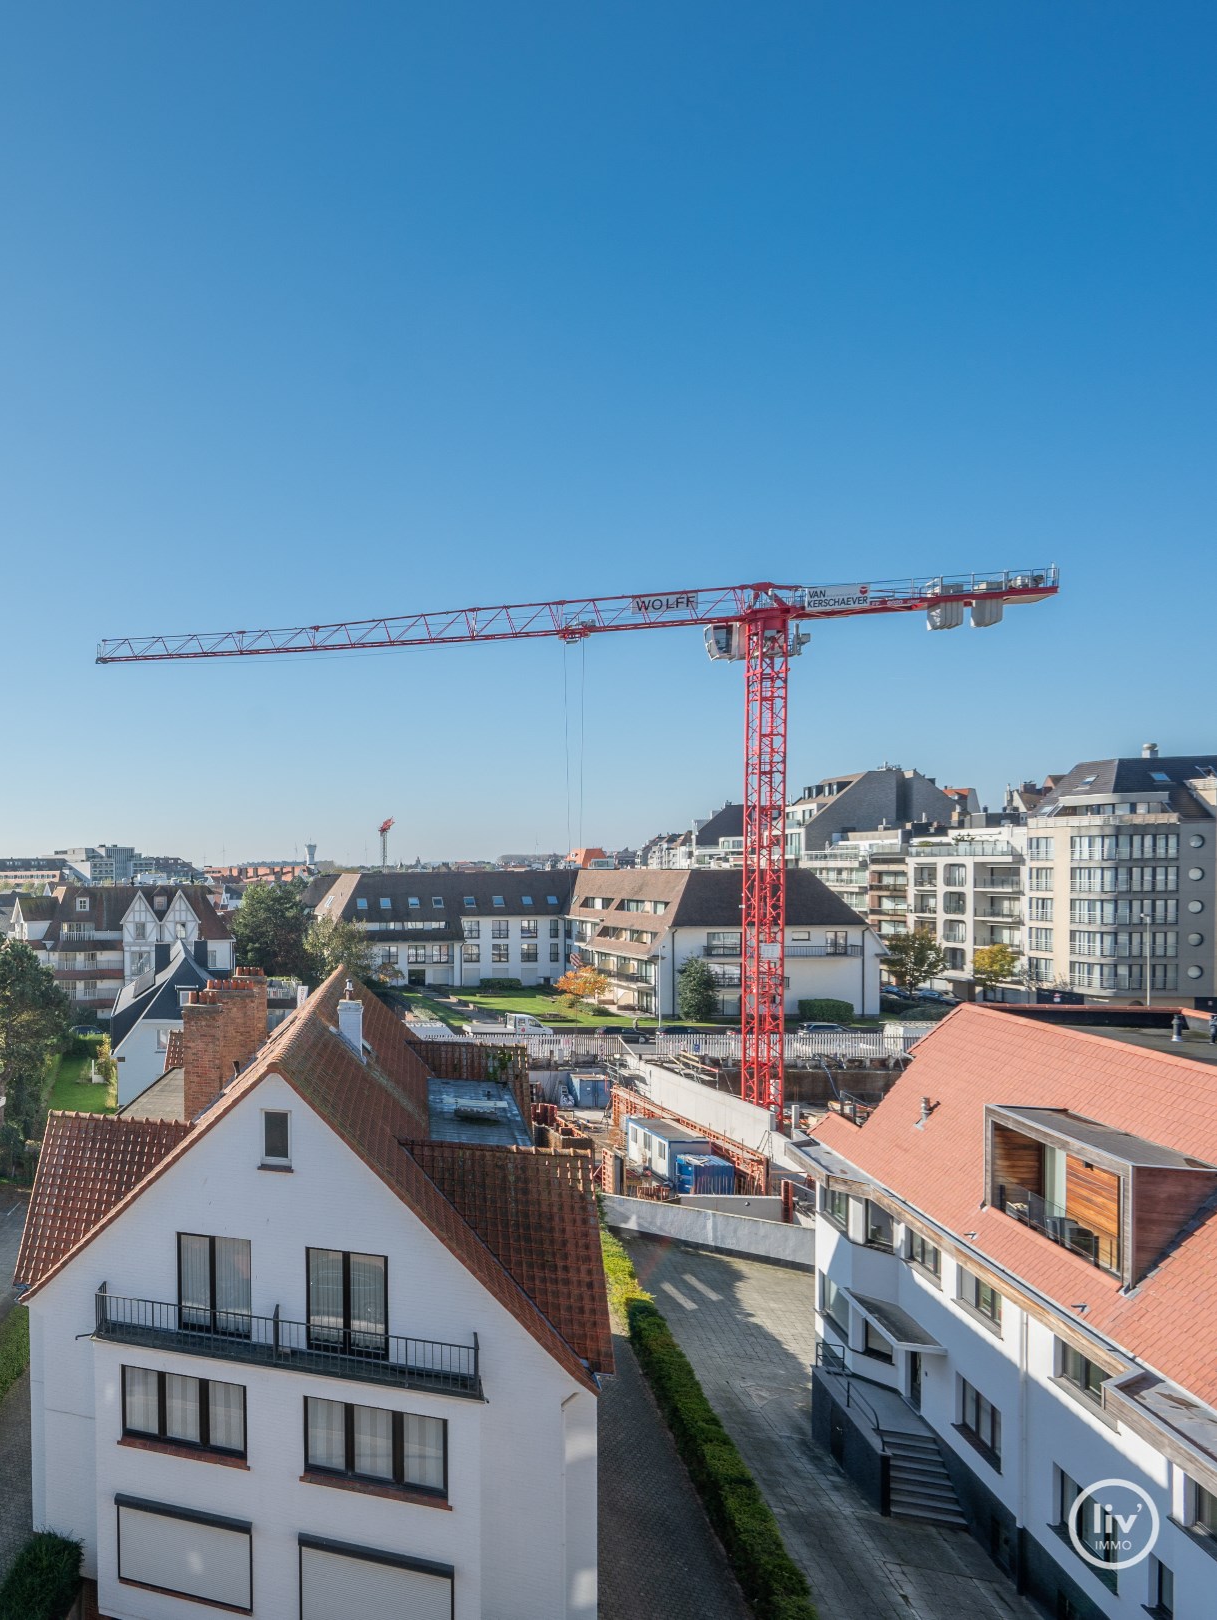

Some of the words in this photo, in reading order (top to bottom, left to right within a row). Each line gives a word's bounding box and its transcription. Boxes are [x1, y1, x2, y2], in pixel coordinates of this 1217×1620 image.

[808, 590, 826, 599] VAN
[636, 596, 695, 611] WOLFF
[807, 596, 868, 608] KERSCHAEVER
